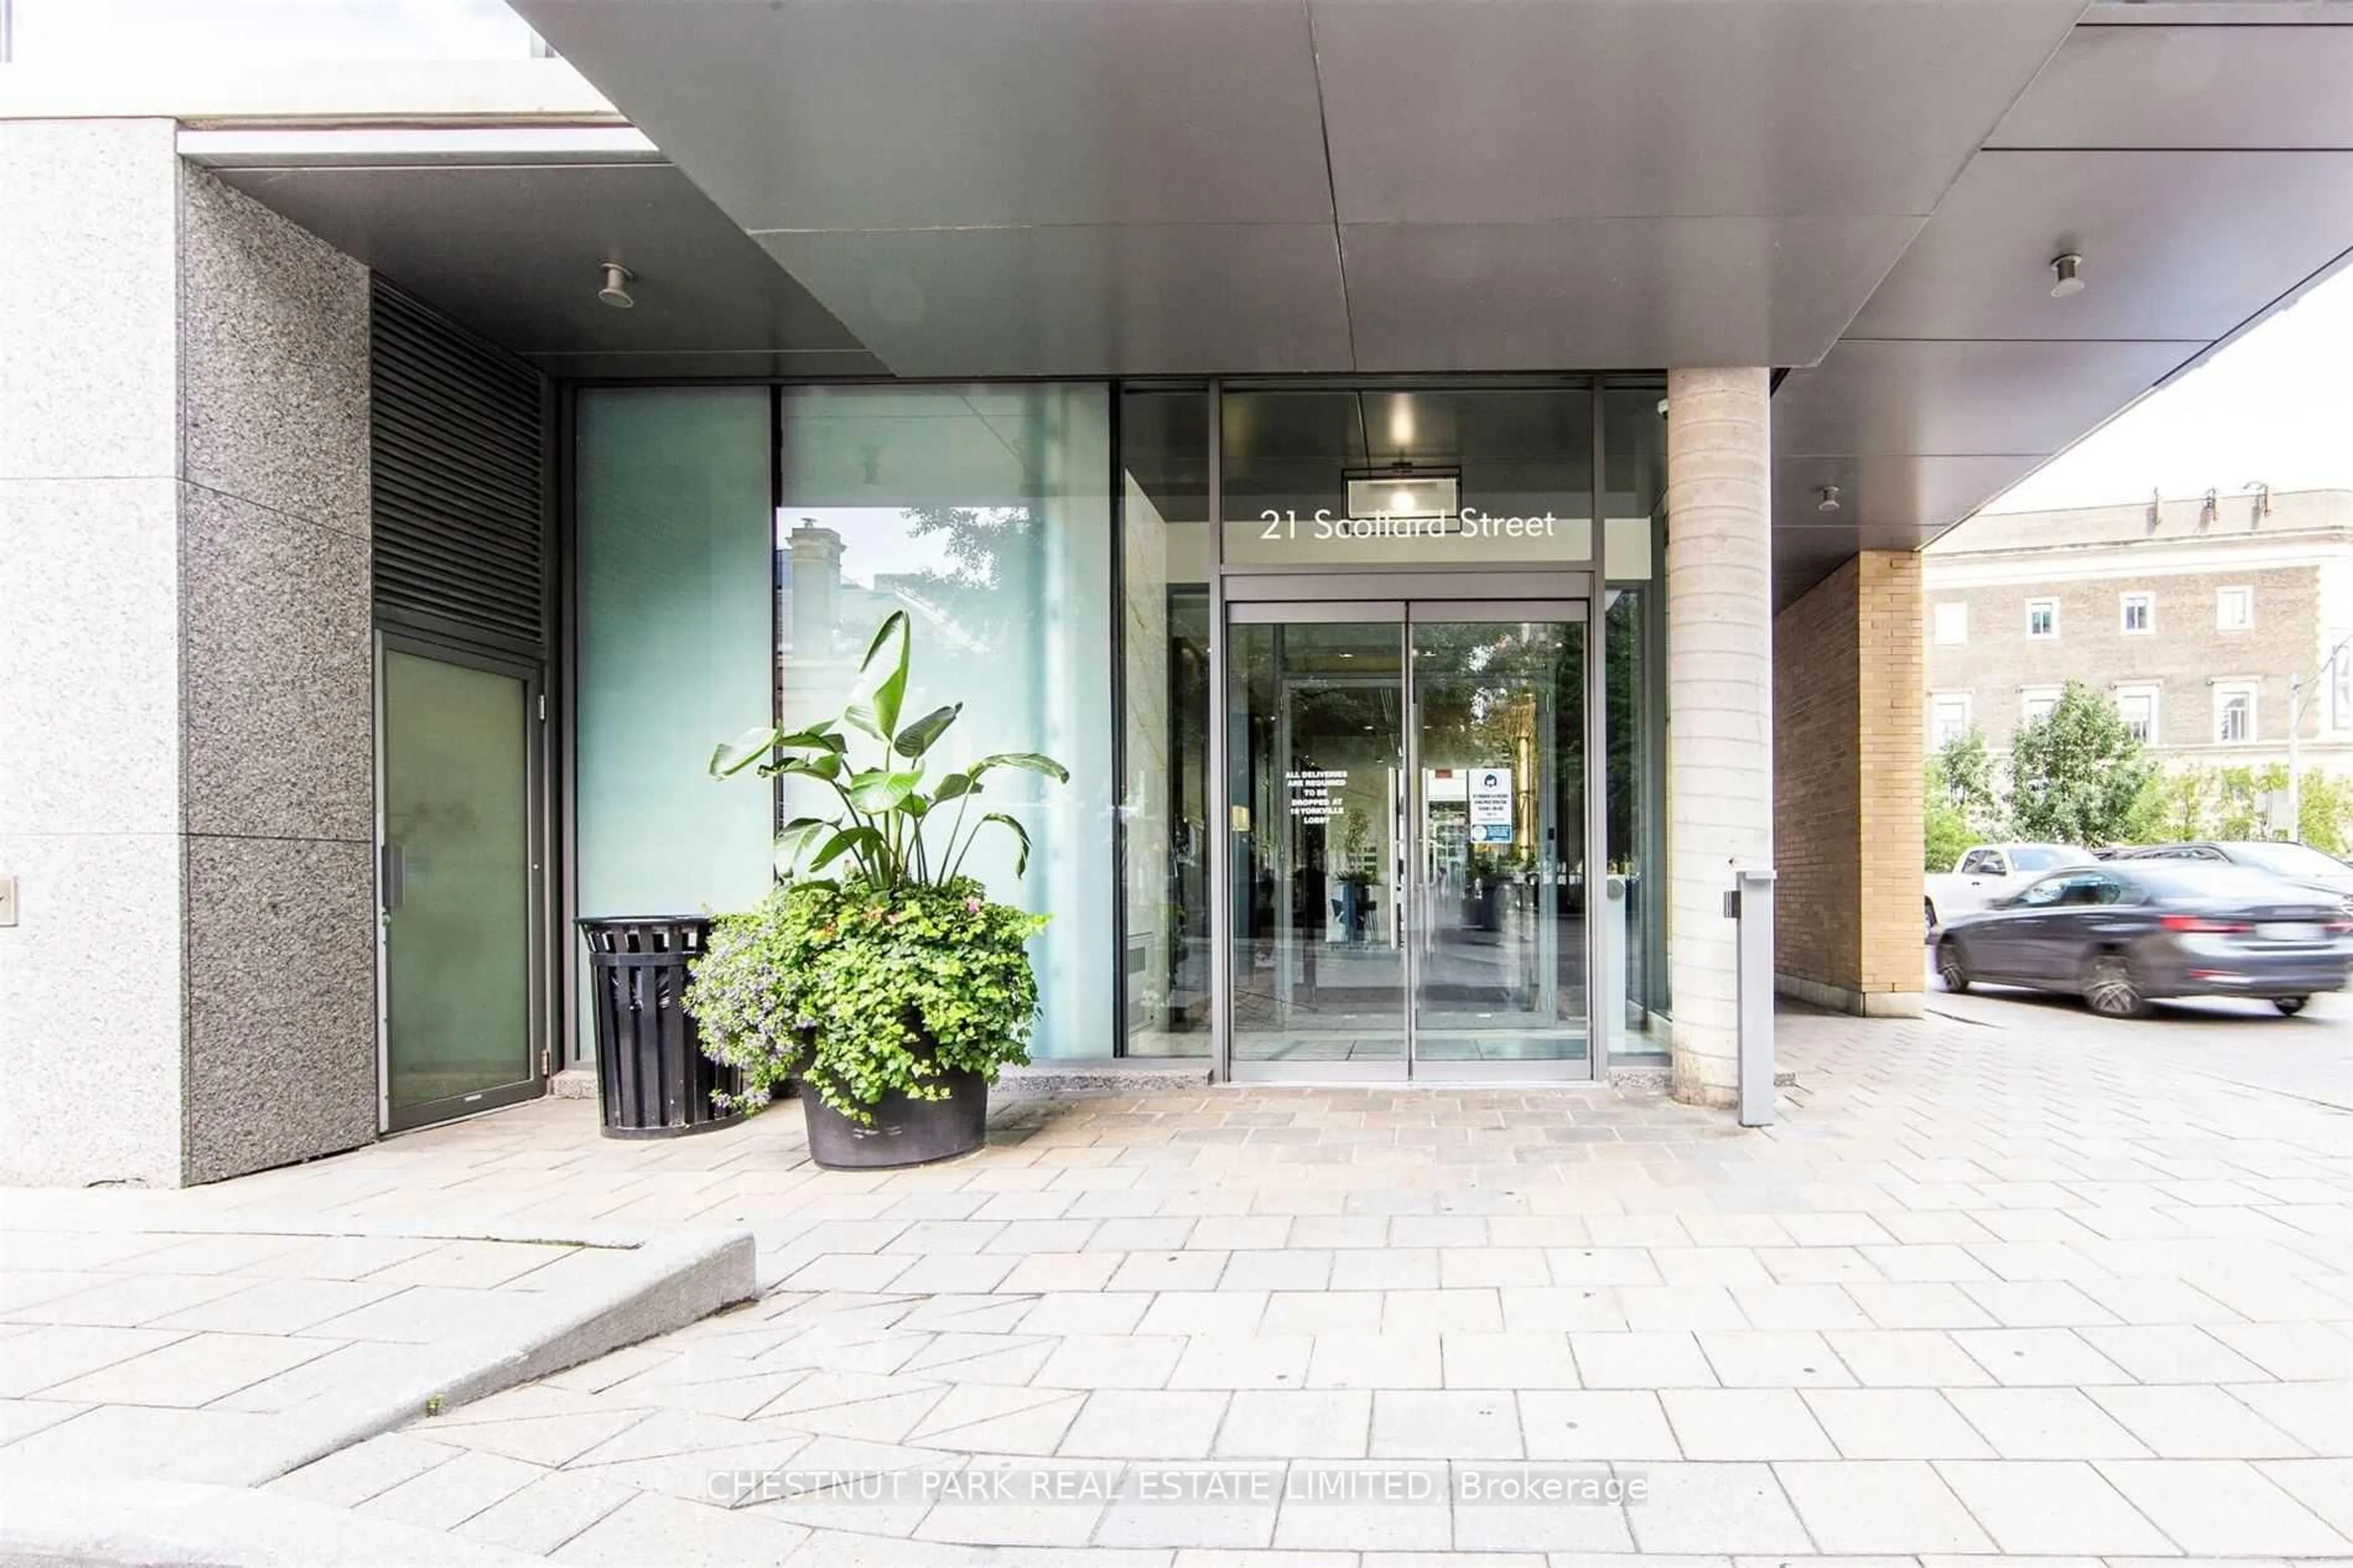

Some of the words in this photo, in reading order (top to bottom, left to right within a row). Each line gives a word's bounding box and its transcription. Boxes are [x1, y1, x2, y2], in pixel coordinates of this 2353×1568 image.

[1259, 510, 1296, 540] 21
[1314, 509, 1446, 539] Scollard
[1459, 507, 1556, 537] Street
